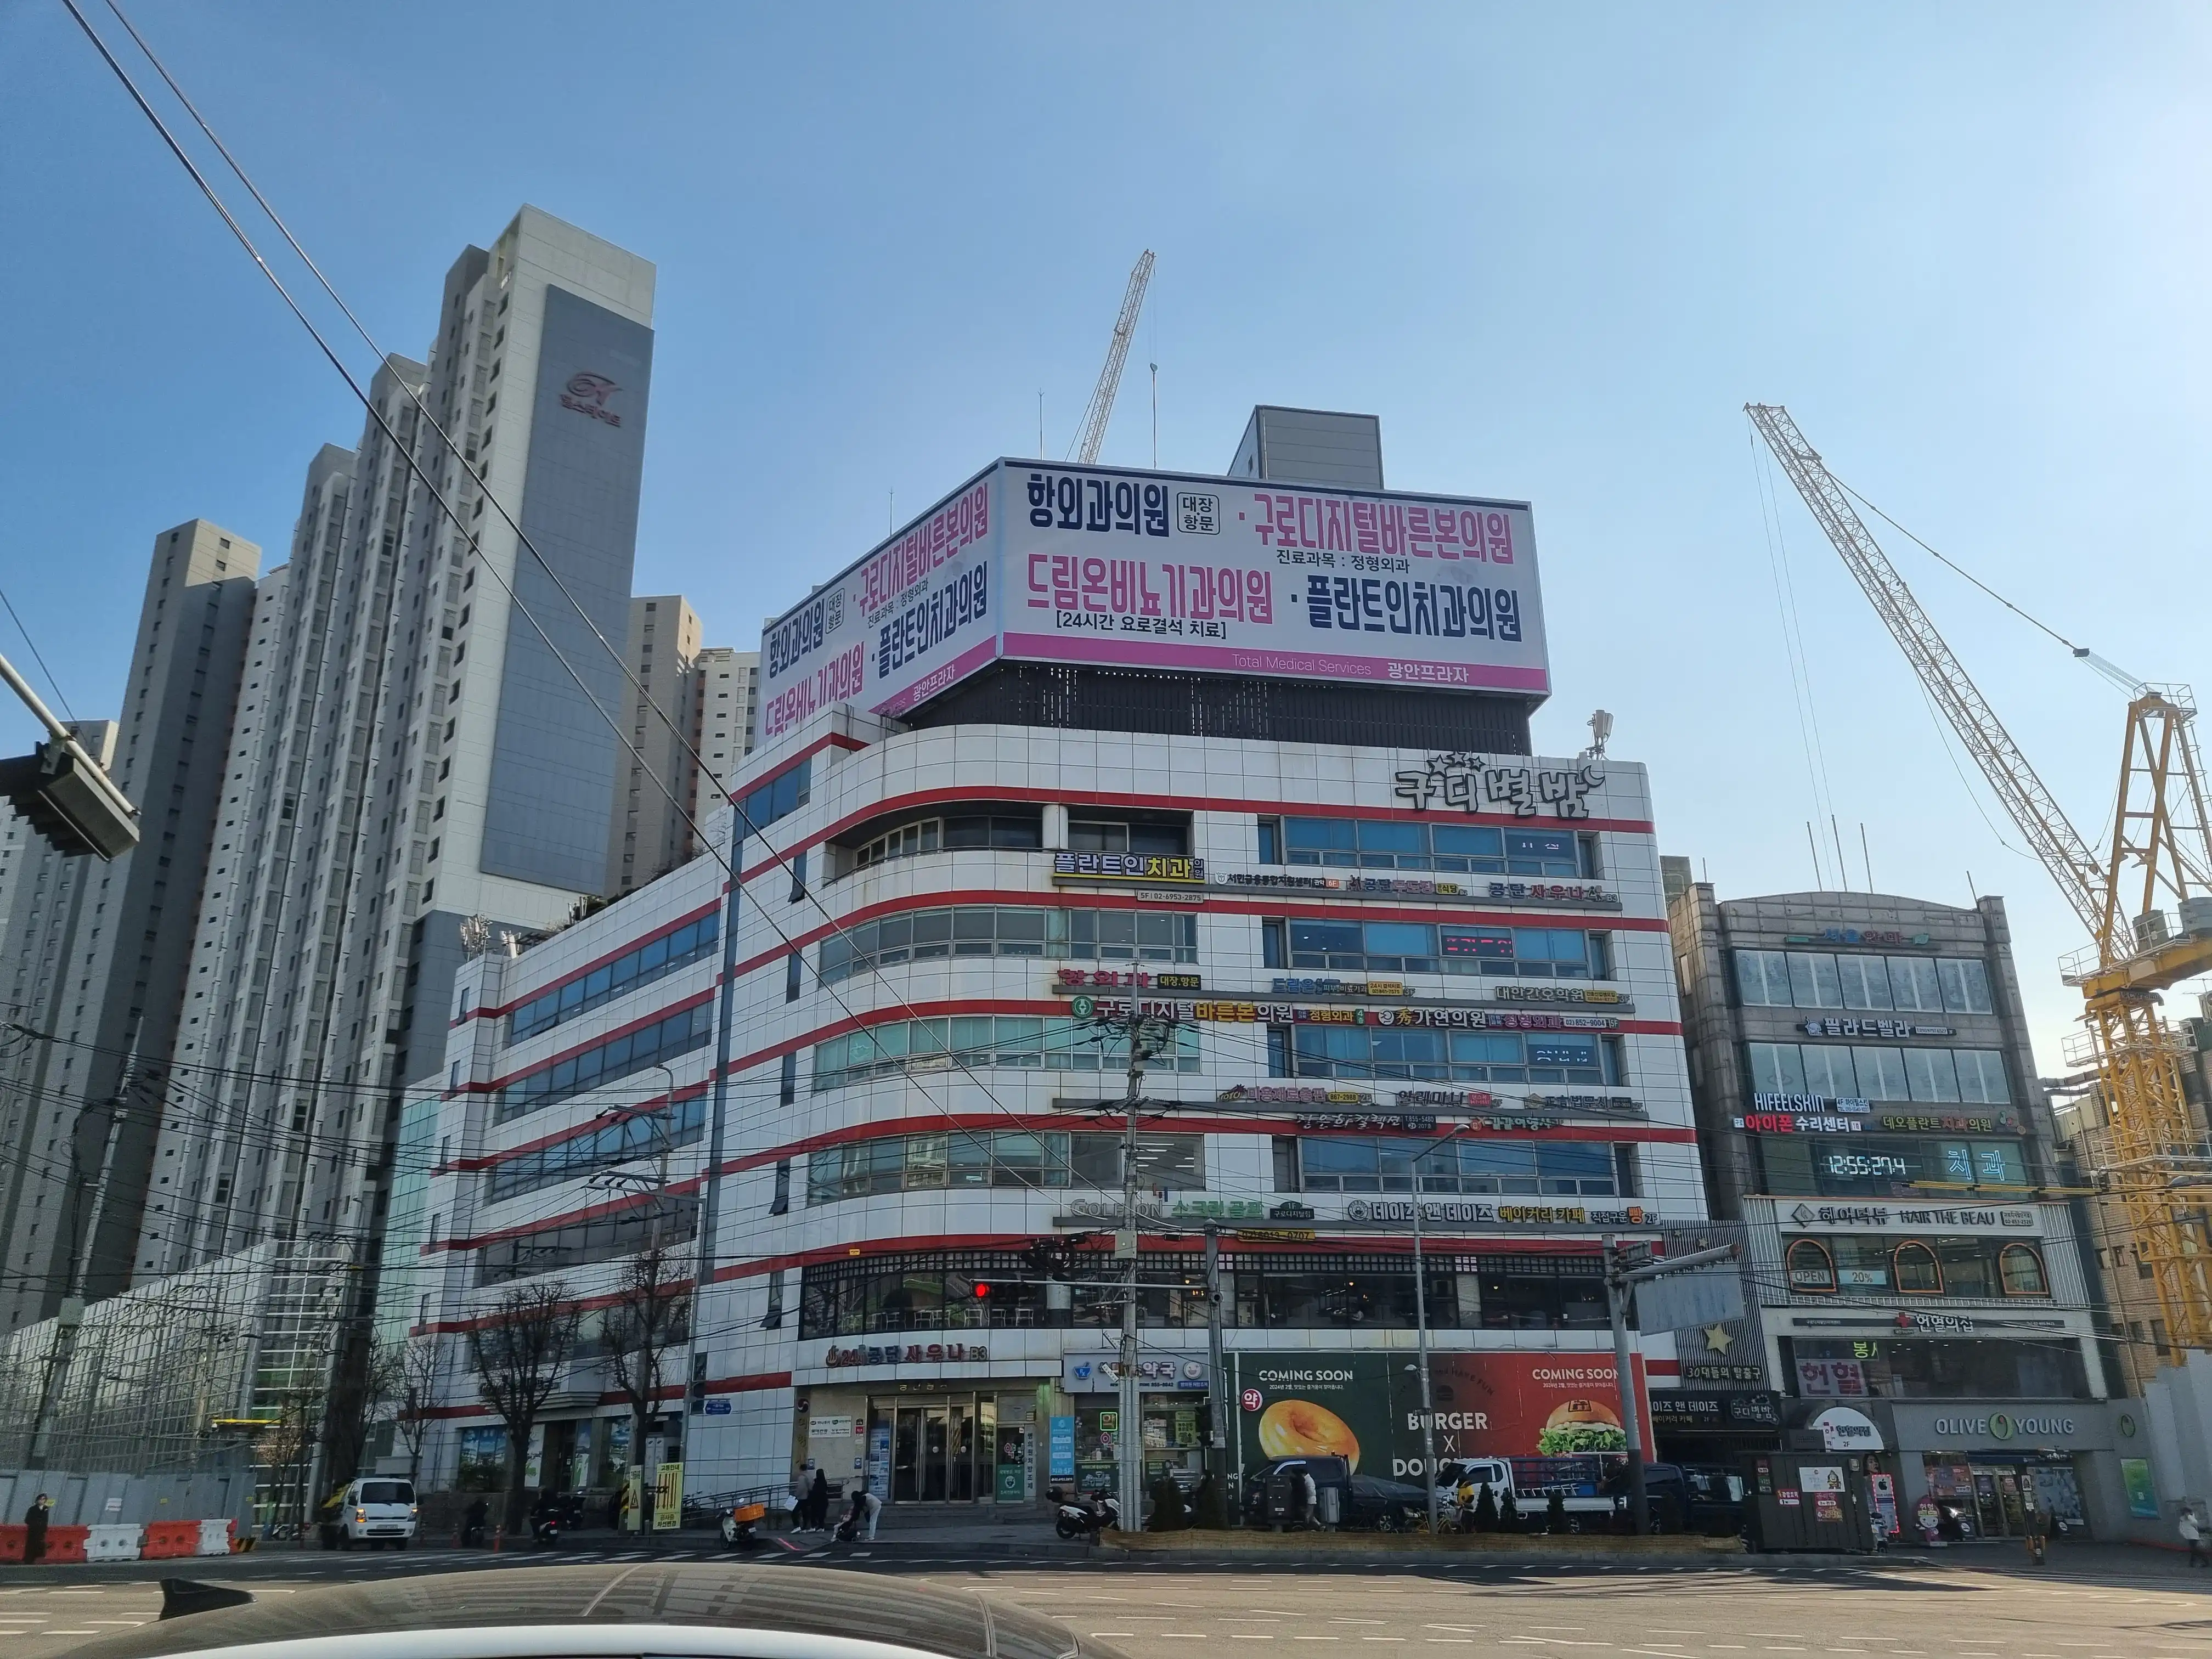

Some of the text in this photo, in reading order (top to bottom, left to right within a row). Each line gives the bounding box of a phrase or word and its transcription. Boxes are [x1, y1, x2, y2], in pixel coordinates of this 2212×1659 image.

[1028, 473, 1169, 537] 항외과의원
[1182, 496, 1213, 515] 대장
[1183, 514, 1214, 532] 항문
[1255, 493, 1513, 565] 구로디지털바른본의원
[860, 483, 988, 617] 구로디지털바른본의원
[1276, 549, 1410, 575] 진료과목 정형외과
[1028, 554, 1273, 624] 드림온비뇨기과의원
[867, 578, 928, 629] 진료과목 정형외과
[1307, 574, 1522, 642] 플란트인치과의원
[879, 561, 987, 679] 플란트인치과의원
[1057, 611, 1115, 632] [24시간
[1119, 614, 1183, 637] 요로결석
[769, 598, 825, 679] 항외과의원
[1232, 653, 1372, 675] Total Medical Services
[1387, 662, 1469, 684] 광안프라자
[913, 663, 955, 702] 광안프라자
[1054, 852, 1192, 879] 플란트인치과
[1154, 893, 1201, 901] 02-6953-2875
[1606, 894, 1618, 902] B3
[1058, 969, 1152, 988] 항외과
[1495, 986, 1584, 1002] 대한간호학원
[1310, 1009, 1354, 1022] 정형외과
[1247, 1086, 1327, 1103] 미용재료총판
[1745, 1115, 1795, 1132] 아이폰
[1796, 1116, 1850, 1132] 수리센터
[1372, 1201, 1423, 1222] 데이즈
[1424, 1203, 1442, 1222] 앤
[1444, 1203, 1494, 1222] 데이즈
[1499, 1205, 1554, 1223] 베이커리
[1556, 1207, 1586, 1224] 카페
[1900, 1210, 1931, 1224] HAIR
[1934, 1211, 1960, 1224] THE
[1795, 1271, 1826, 1282] OPEN
[1852, 1271, 1874, 1283] 20%
[1915, 1313, 1974, 1334] 헌혈의집
[970, 1346, 988, 1362] B3
[1259, 1370, 1354, 1381] COMING SOON
[1532, 1369, 1584, 1380] COMING
[1800, 1362, 1864, 1395] 헌혈
[1244, 1392, 1258, 1409] 약
[1675, 1401, 1686, 1412] 앤
[1688, 1401, 1719, 1412] 데이즈
[1407, 1412, 1488, 1431] BURGER
[1936, 1418, 2075, 1435] OLIVE YOUNG
[1444, 1435, 1457, 1453] X
